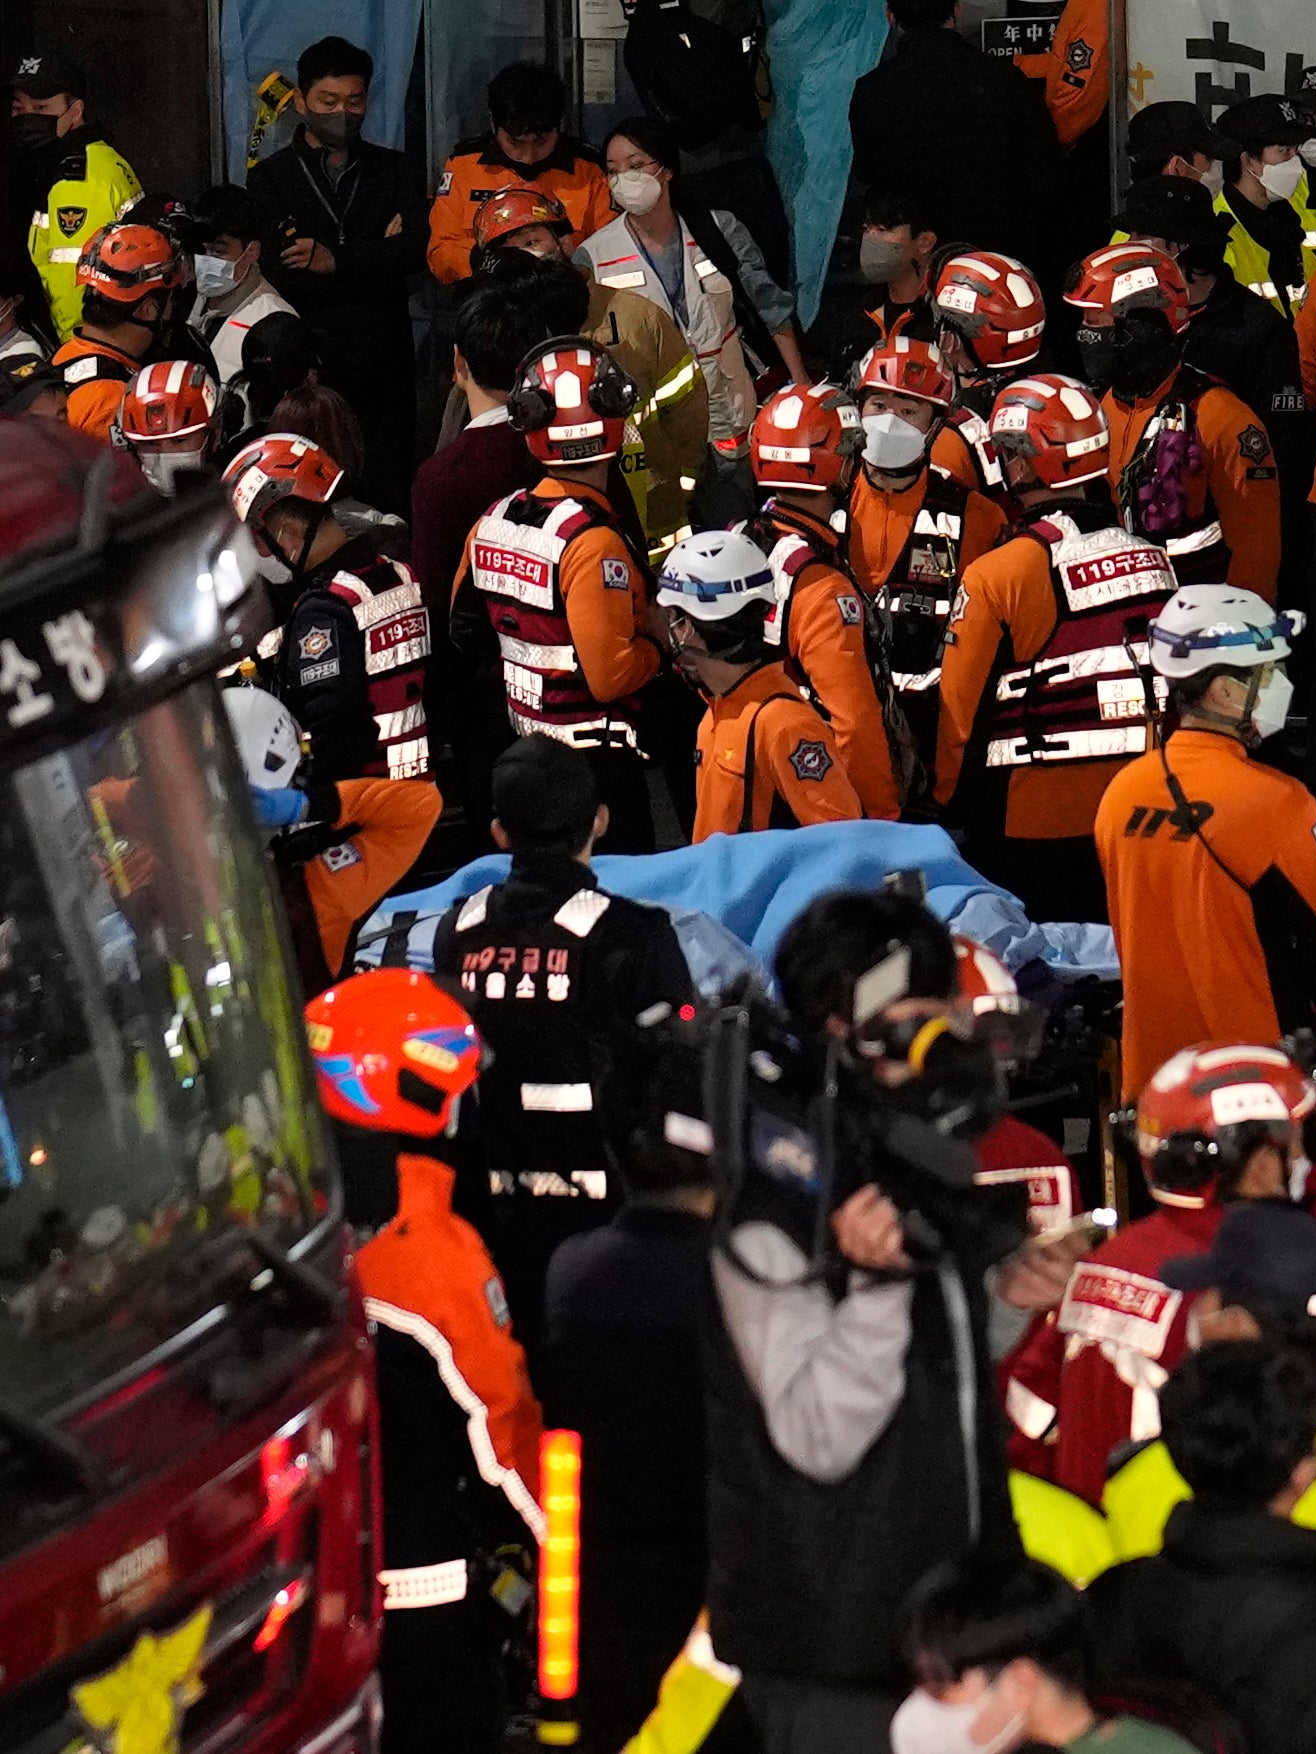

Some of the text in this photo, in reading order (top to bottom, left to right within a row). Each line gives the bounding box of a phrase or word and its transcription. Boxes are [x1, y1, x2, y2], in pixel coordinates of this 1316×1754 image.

[1003, 24, 1057, 43] 年中
[1274, 396, 1304, 410] FIRE
[478, 549, 543, 584] 119구조대
[1076, 551, 1165, 583] 119구조대
[0, 609, 105, 728] 소방
